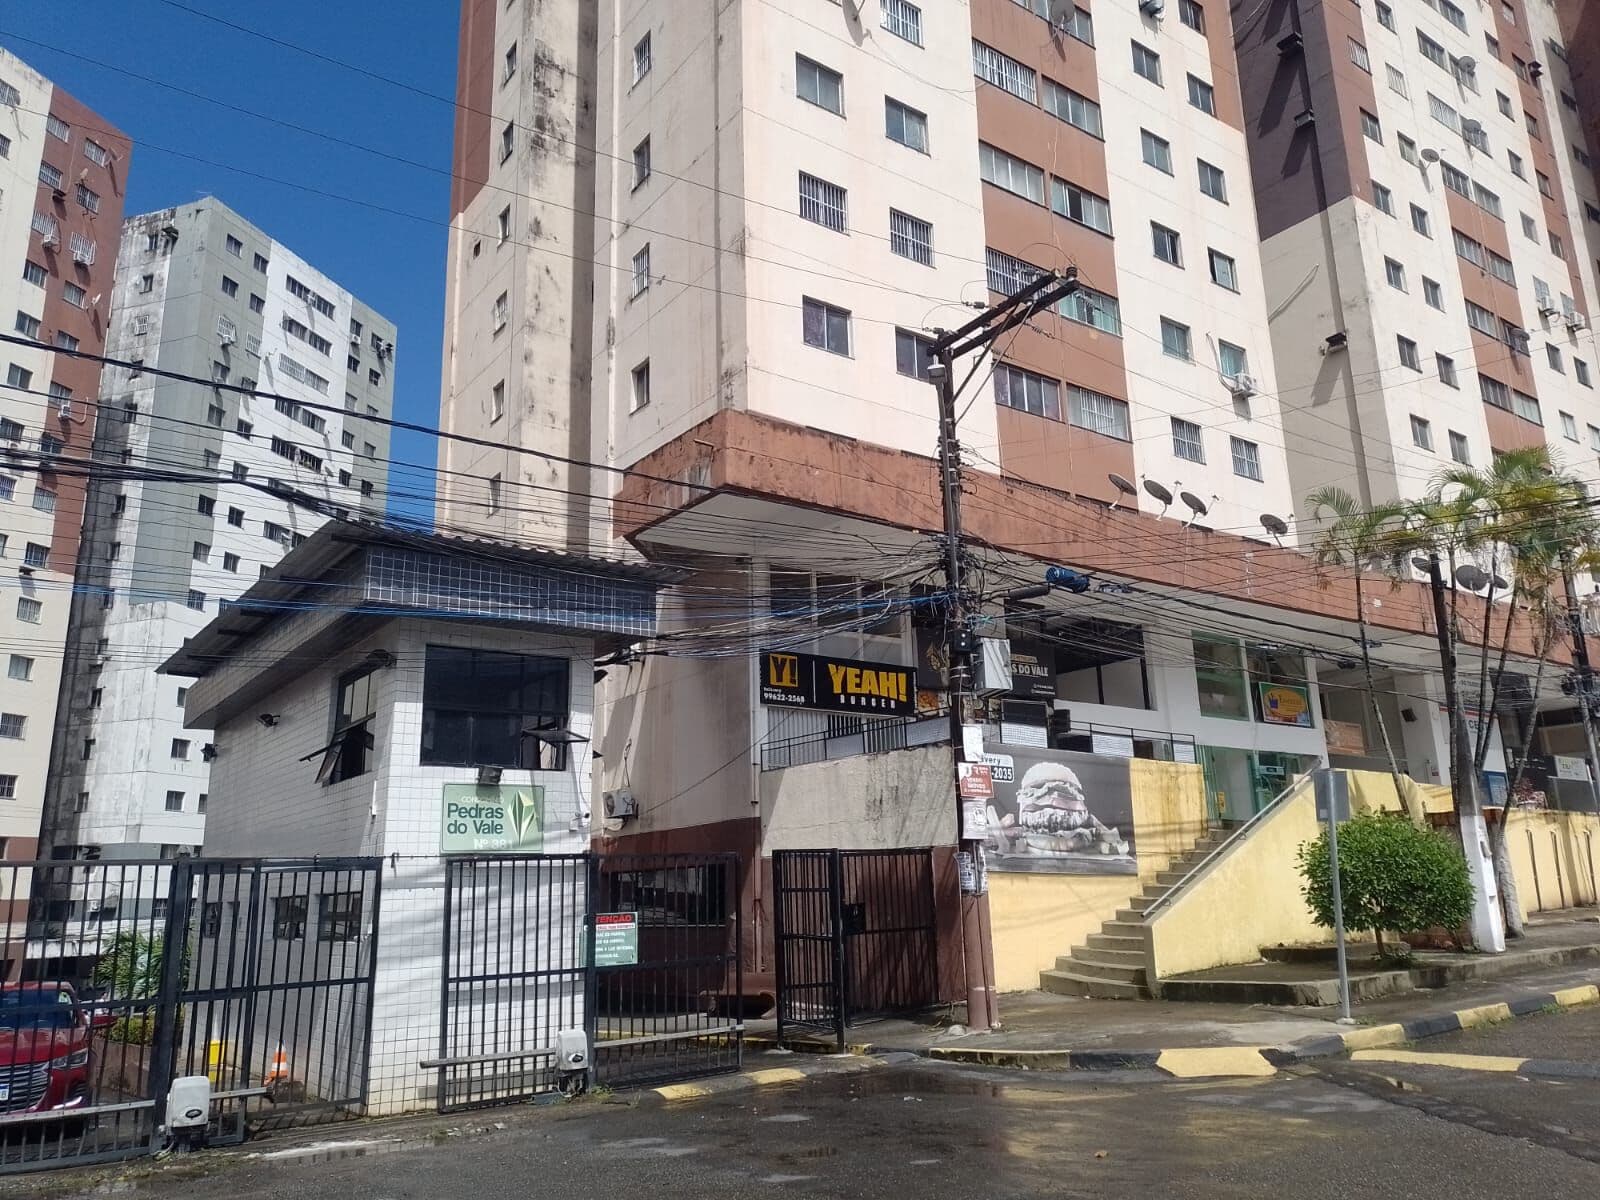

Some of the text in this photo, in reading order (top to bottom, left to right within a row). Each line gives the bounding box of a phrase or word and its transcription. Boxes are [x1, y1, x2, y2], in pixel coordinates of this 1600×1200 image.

[1018, 664, 1030, 674] DO
[1031, 665, 1049, 677] VALE
[828, 663, 907, 702] YEAH!
[840, 693, 896, 709] BURGER
[447, 802, 504, 819] Pedras
[446, 820, 504, 835] do Vale
